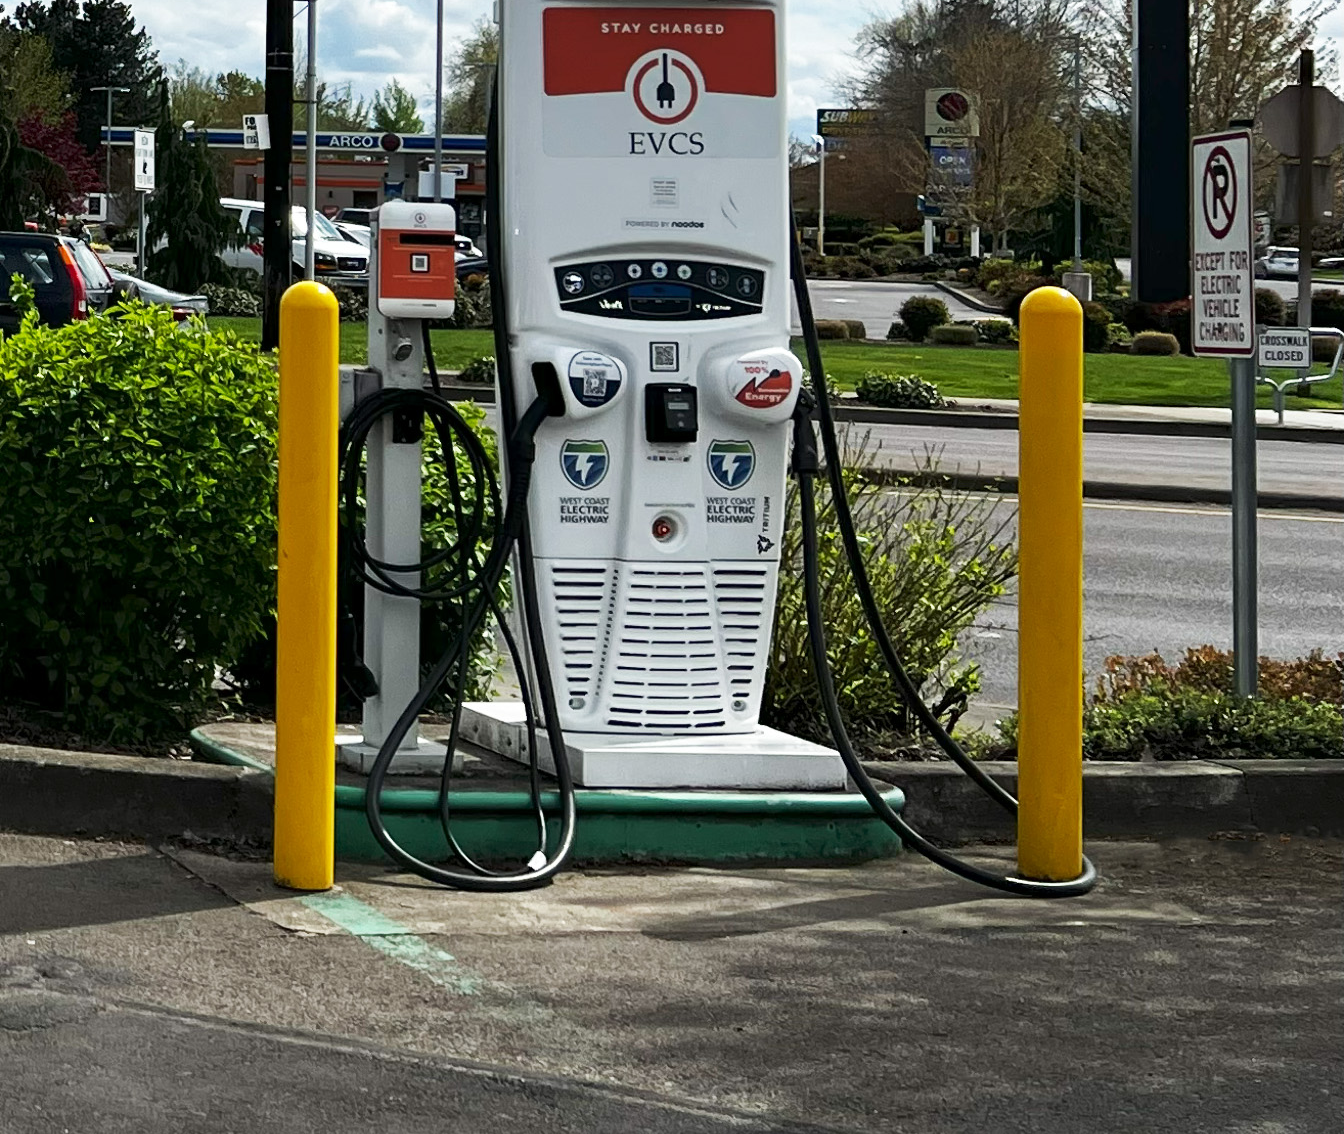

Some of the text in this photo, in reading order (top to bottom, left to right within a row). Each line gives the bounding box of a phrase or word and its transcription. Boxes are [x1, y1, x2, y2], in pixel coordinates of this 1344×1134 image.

[601, 23, 725, 34] STAY CHARGED
[937, 126, 968, 134] ARCO
[329, 135, 373, 148] ARCO
[628, 132, 705, 155] EVCS
[1196, 251, 1248, 271] EXCEPT FOR
[1201, 275, 1242, 295] ELECTRIC
[1203, 298, 1240, 318] VEHICLE
[1199, 322, 1245, 342] CHARGING
[1260, 334, 1308, 347] CROSSWALK
[1264, 350, 1304, 361] CLOSED
[745, 392, 781, 402] Energy
[584, 497, 610, 505] COAST
[730, 497, 756, 505] COAST
[561, 505, 609, 514] ELECTRIC
[707, 505, 755, 514] ELECTRIC
[560, 515, 609, 523] HIGHWAY
[707, 515, 755, 523] HIGHWAY
